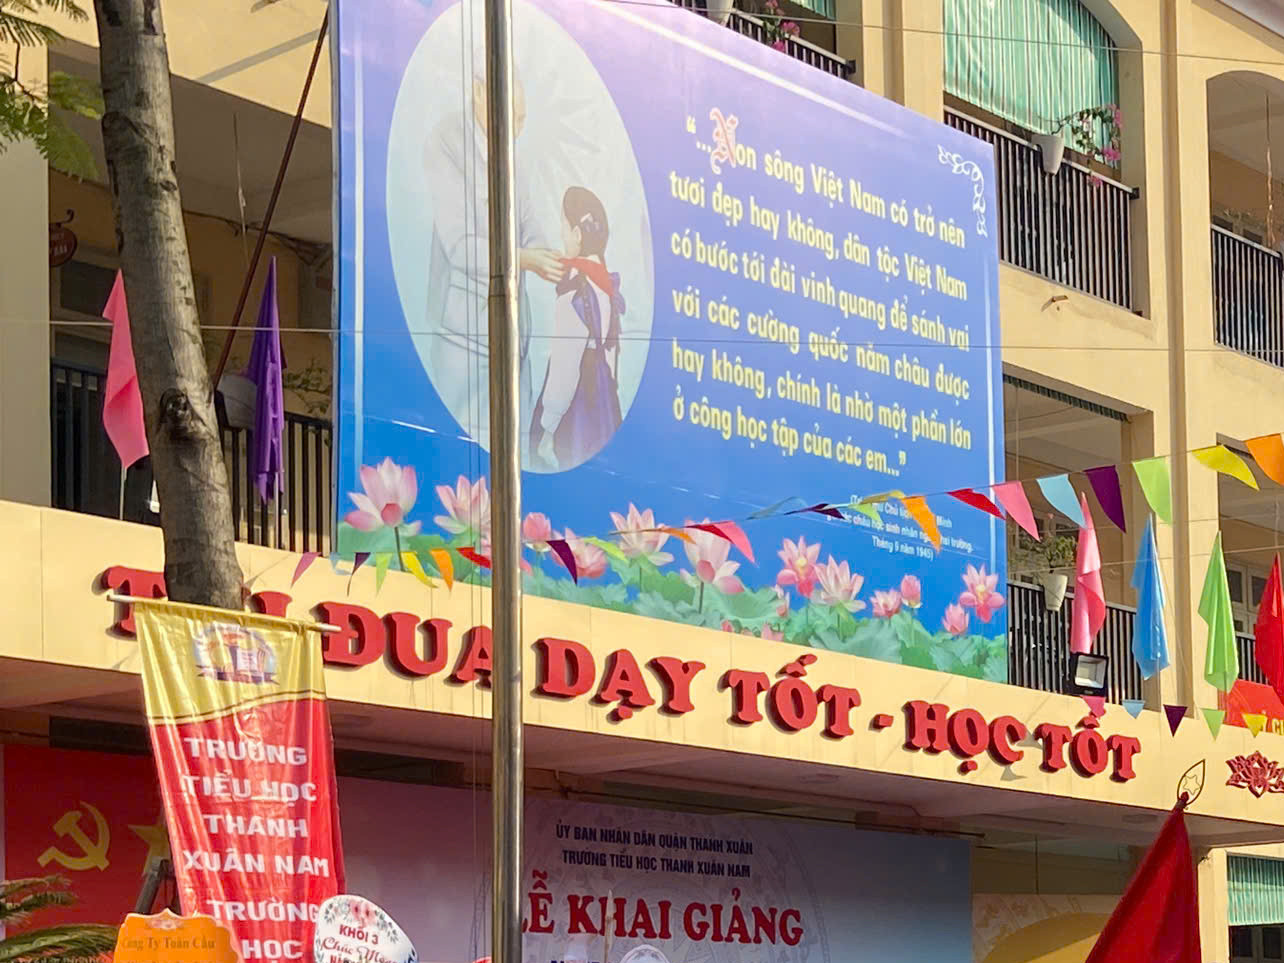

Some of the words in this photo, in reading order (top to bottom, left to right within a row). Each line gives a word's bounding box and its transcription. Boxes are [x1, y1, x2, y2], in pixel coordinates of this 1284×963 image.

[670, 172, 705, 208] tươi
[713, 182, 743, 228] đẹp
[750, 196, 780, 239] hay
[788, 211, 839, 261] không,
[843, 232, 870, 267] dân
[877, 247, 899, 282] tộc
[904, 255, 932, 295] Việt
[936, 268, 967, 300] Nam
[765, 151, 804, 194] sông
[811, 164, 843, 208] Việt
[850, 180, 885, 220] Nam
[891, 199, 908, 227] có
[913, 206, 935, 237] trở
[939, 218, 965, 248] nên
[671, 228, 692, 259] có
[696, 231, 738, 274] bước
[742, 248, 765, 284] tới
[771, 257, 795, 294] đài
[802, 273, 835, 308] vinh
[839, 289, 886, 329] quang
[891, 297, 908, 331] để
[912, 310, 945, 345] sánh
[949, 324, 970, 352] vai
[672, 288, 699, 319] với
[708, 297, 740, 330] các
[748, 309, 799, 354] cường
[809, 327, 848, 362] quốc
[857, 345, 890, 376] năm
[895, 354, 930, 389] châu
[936, 363, 970, 406] được
[672, 338, 704, 382] hay
[712, 349, 772, 399] không,
[778, 371, 820, 408] chính
[826, 382, 841, 414] là
[846, 390, 874, 423] nhờ
[878, 402, 907, 439] một
[912, 409, 946, 443] phần
[950, 420, 971, 450] lớn
[673, 385, 684, 421] ở
[690, 397, 731, 440] công
[737, 406, 767, 449] học
[772, 417, 798, 457] tập
[804, 422, 832, 460] của
[837, 436, 862, 466] các
[316, 601, 492, 687] ĐUA
[533, 637, 705, 722] DẠY
[719, 653, 861, 739] TỐT
[904, 700, 1028, 774] HỌC
[183, 847, 265, 874] XUÂN
[275, 855, 329, 878] NAM
[202, 814, 308, 837] THANH
[574, 826, 597, 841] BAN
[600, 827, 630, 844] NHÂN
[634, 830, 655, 847] DÂN
[690, 837, 723, 852] THANH
[726, 840, 753, 855] XUÂN
[636, 856, 657, 874] HỌC
[660, 859, 694, 874] THANH
[698, 861, 724, 876] XUÂN
[728, 864, 751, 878] NAM
[207, 898, 318, 922] TRƯỜNG
[372, 934, 379, 945] 3
[522, 869, 554, 934] Ễ
[567, 894, 672, 939] KHAI
[683, 888, 804, 946] GIẢNG
